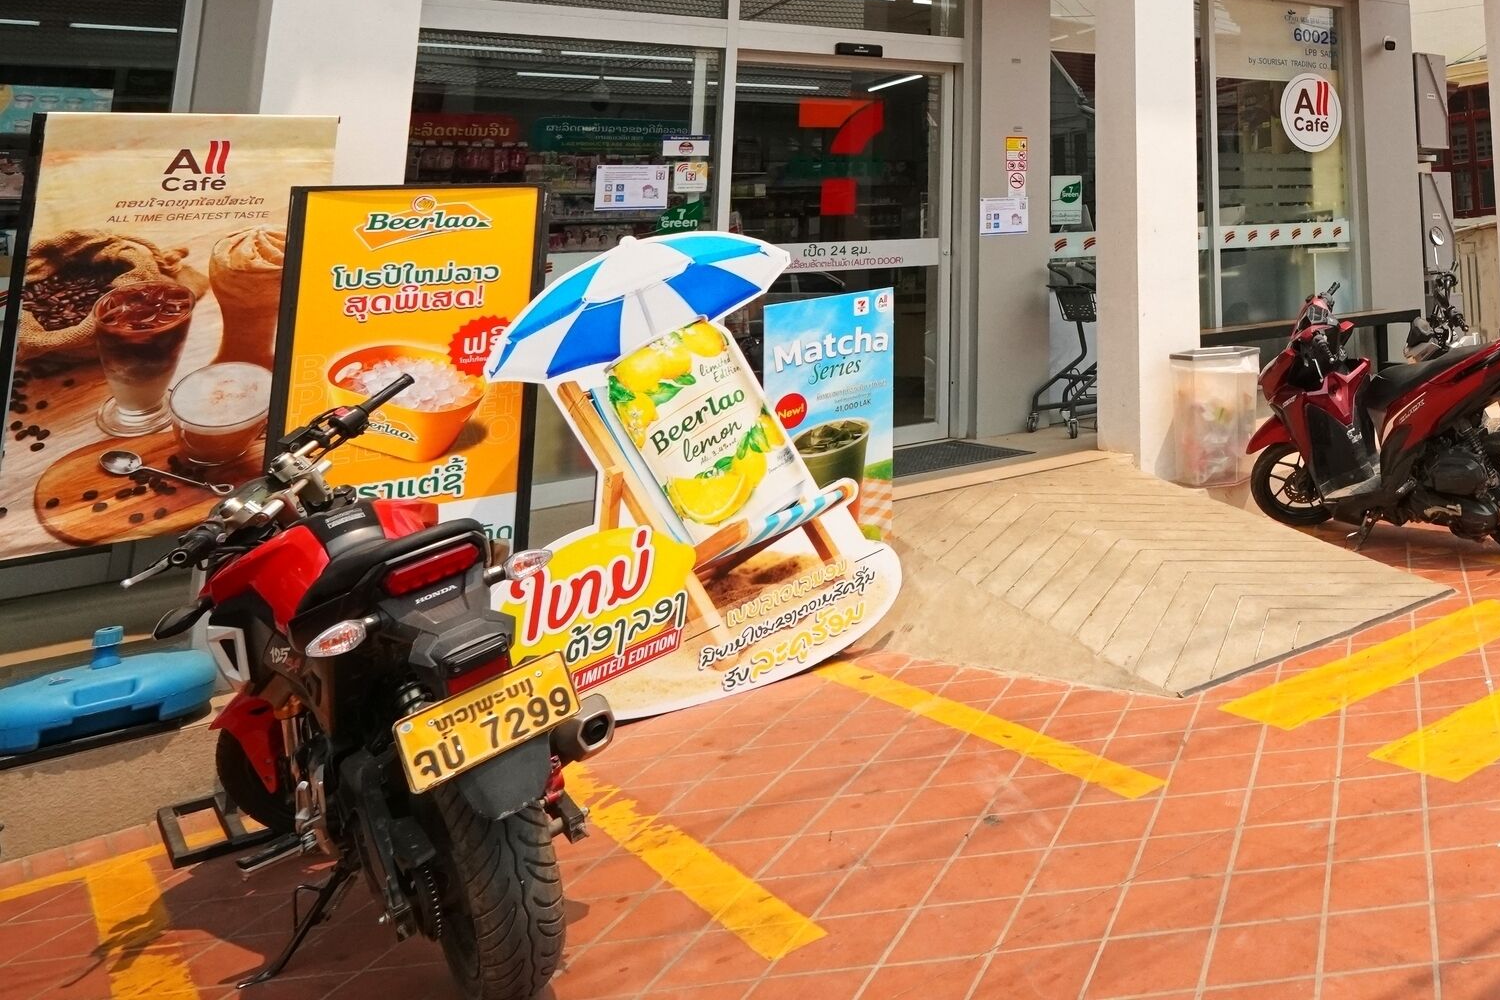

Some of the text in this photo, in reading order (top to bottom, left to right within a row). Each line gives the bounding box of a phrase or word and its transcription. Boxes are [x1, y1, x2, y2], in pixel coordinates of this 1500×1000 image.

[1294, 81, 1329, 116] All
[1294, 116, 1329, 132] Café
[164, 141, 230, 174] All
[162, 175, 226, 191] Café
[107, 211, 270, 223] ALL TIME GREATEST TASTE
[365, 211, 478, 231] Beerlao
[661, 219, 698, 228] Green
[831, 245, 847, 256] 24
[773, 327, 889, 373] Matcha
[808, 355, 862, 385] Series
[777, 403, 805, 419] New!
[650, 389, 745, 455] Beerlao
[414, 584, 457, 605] HONDA
[270, 646, 291, 664] 125
[574, 633, 677, 689] LIMITED EDITION
[480, 686, 571, 749] 7299
